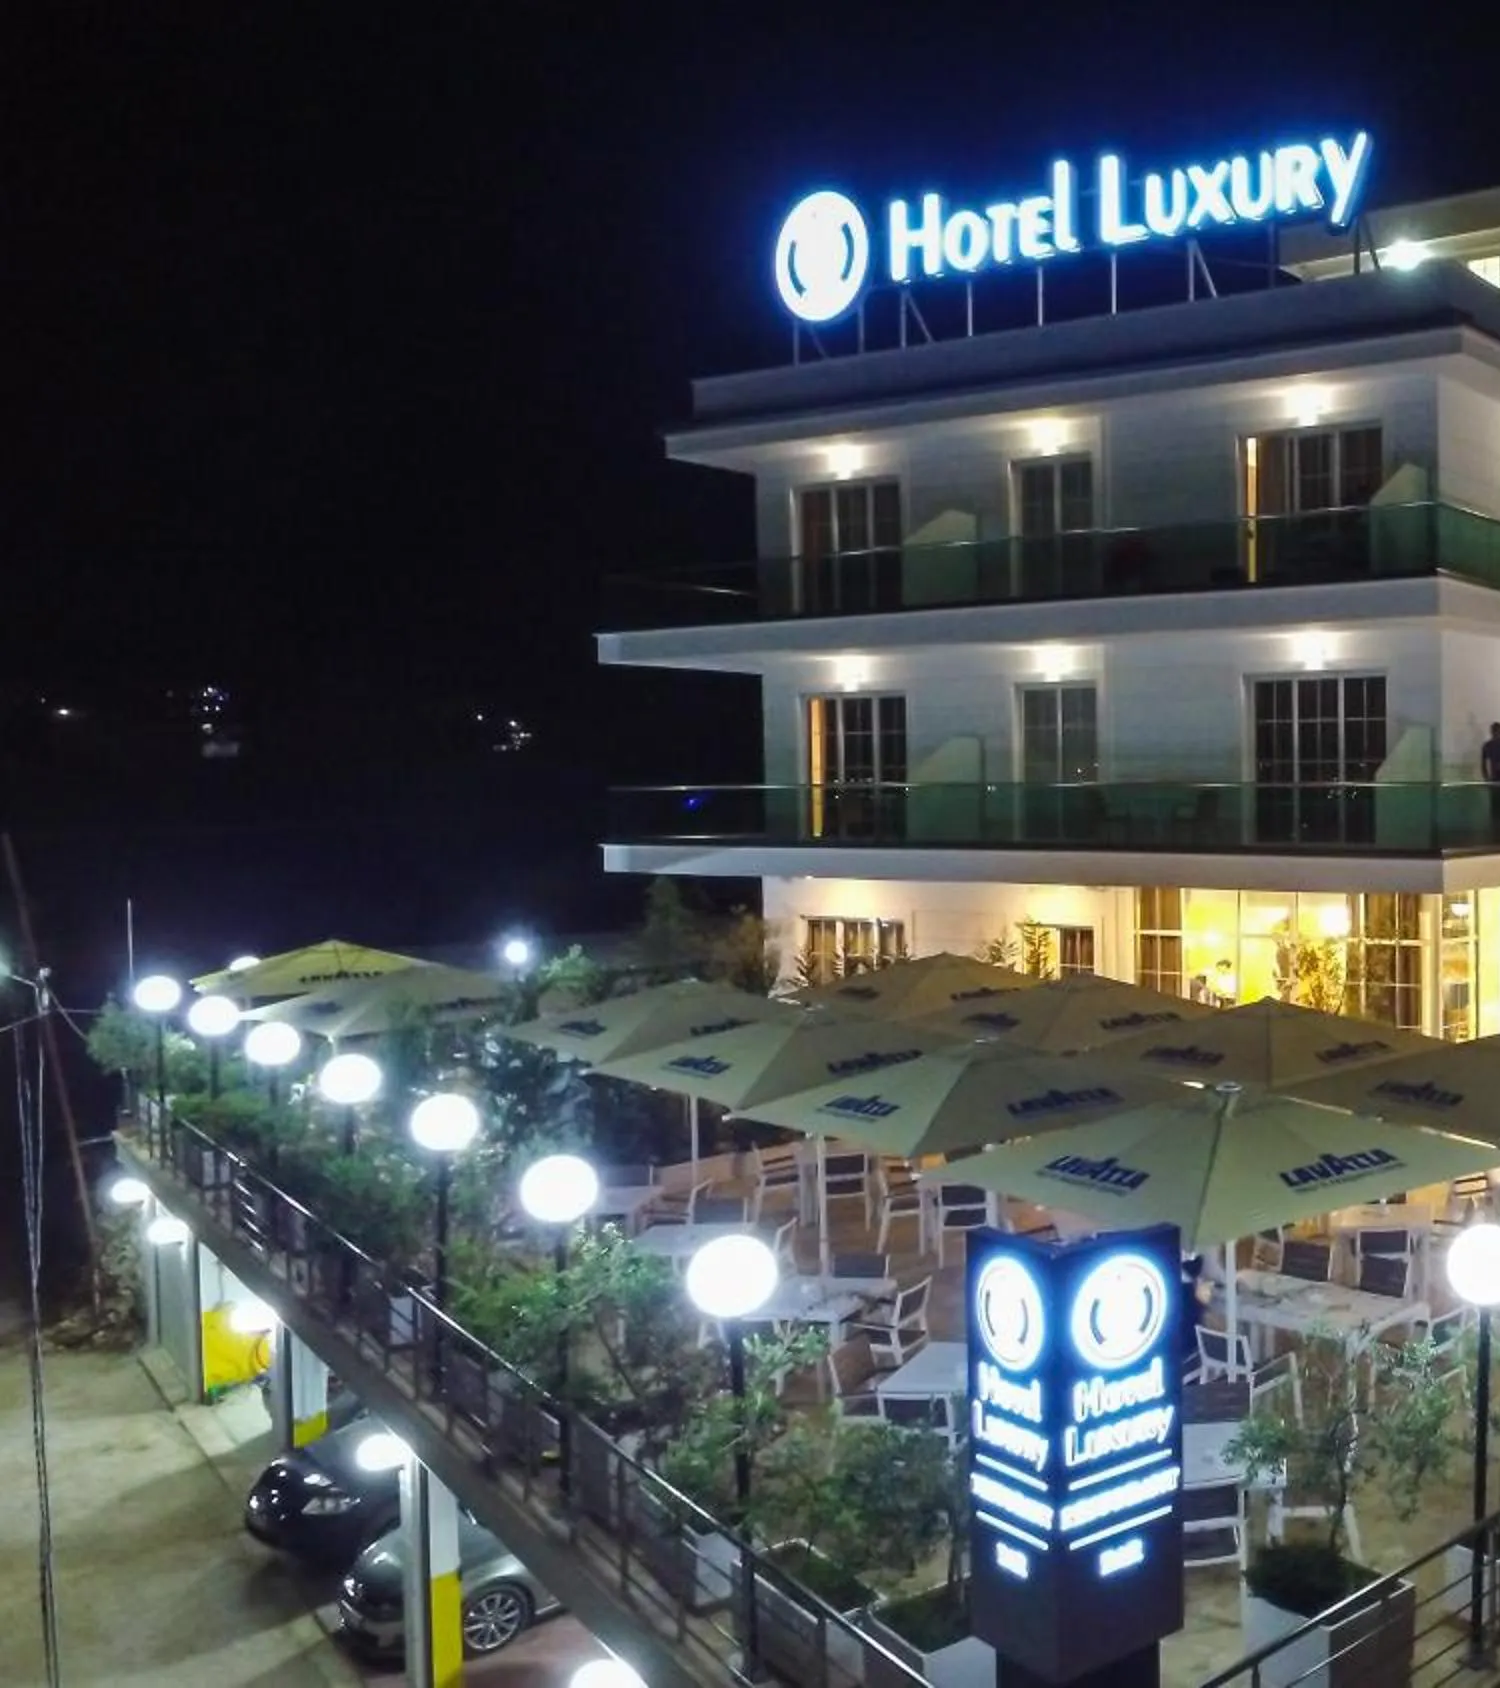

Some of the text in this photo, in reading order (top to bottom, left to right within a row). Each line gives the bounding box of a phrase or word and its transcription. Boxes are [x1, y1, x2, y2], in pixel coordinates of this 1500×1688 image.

[889, 131, 1368, 284] HOTEL LUXURY
[1278, 1148, 1399, 1188] LAVAZZA
